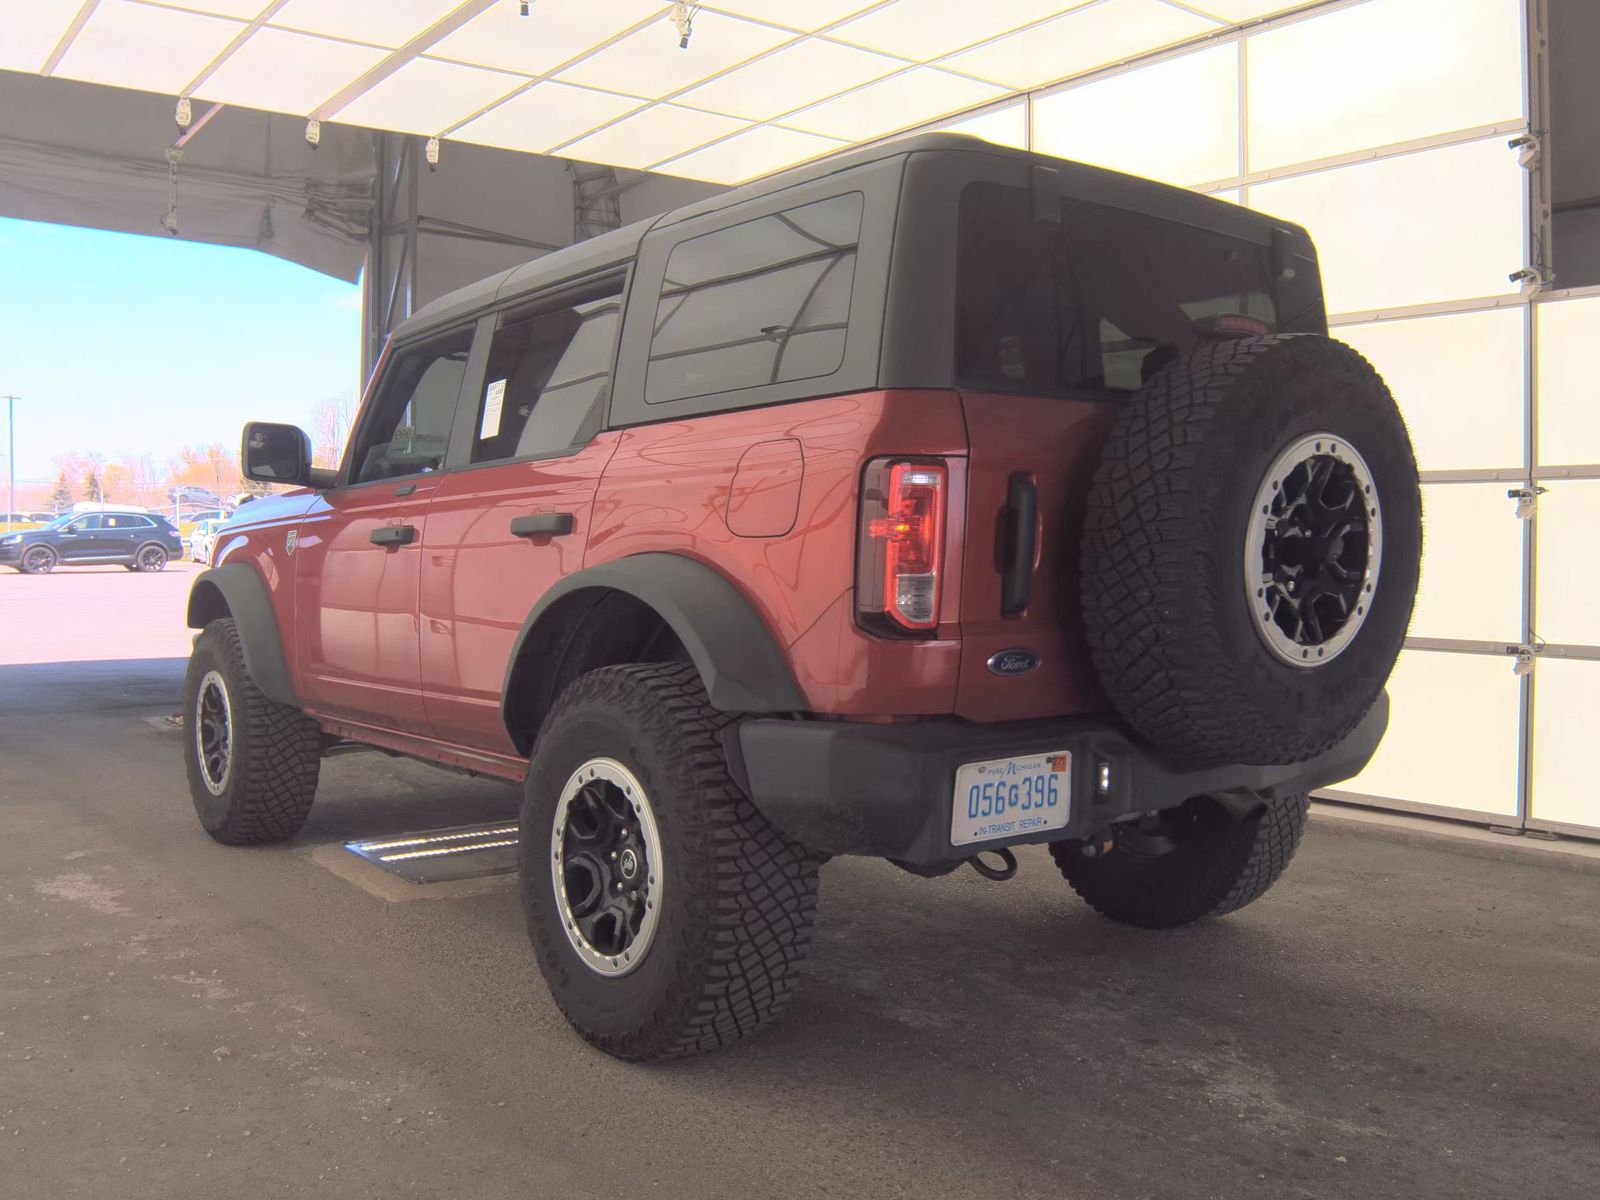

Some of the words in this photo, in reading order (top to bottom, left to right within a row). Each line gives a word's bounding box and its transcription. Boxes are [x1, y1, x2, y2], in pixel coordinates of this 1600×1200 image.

[1000, 655, 1030, 671] Ford
[968, 774, 1058, 819] 056G396
[978, 821, 1016, 836] IN-TRANSIT
[1019, 817, 1043, 829] REPAIR
